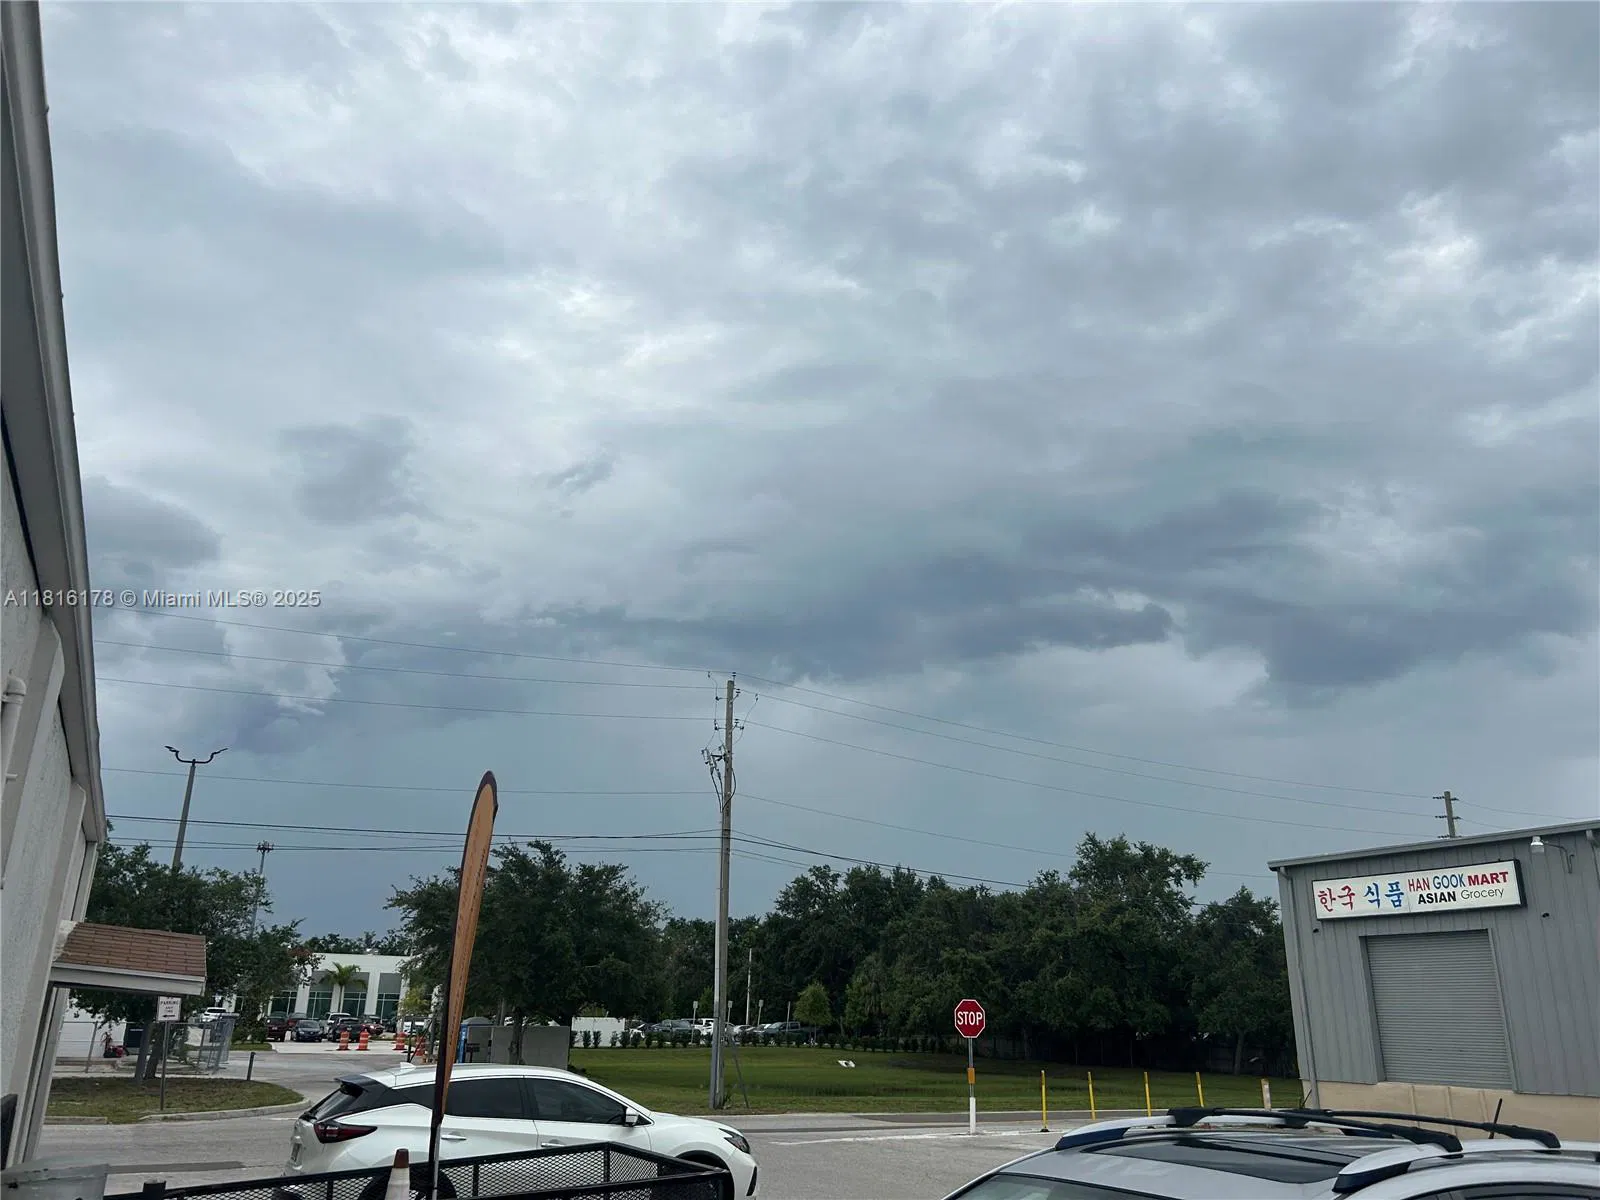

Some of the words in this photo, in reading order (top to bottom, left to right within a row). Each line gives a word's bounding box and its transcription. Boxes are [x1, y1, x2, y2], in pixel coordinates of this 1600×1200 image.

[1408, 877, 1431, 892] HAN
[1432, 873, 1466, 890] GOOK
[1467, 871, 1509, 886] MART
[1317, 885, 1356, 913] 한국
[1417, 891, 1457, 905] ASIAN
[1460, 887, 1505, 903] Grocery
[957, 1011, 983, 1026] STOP
